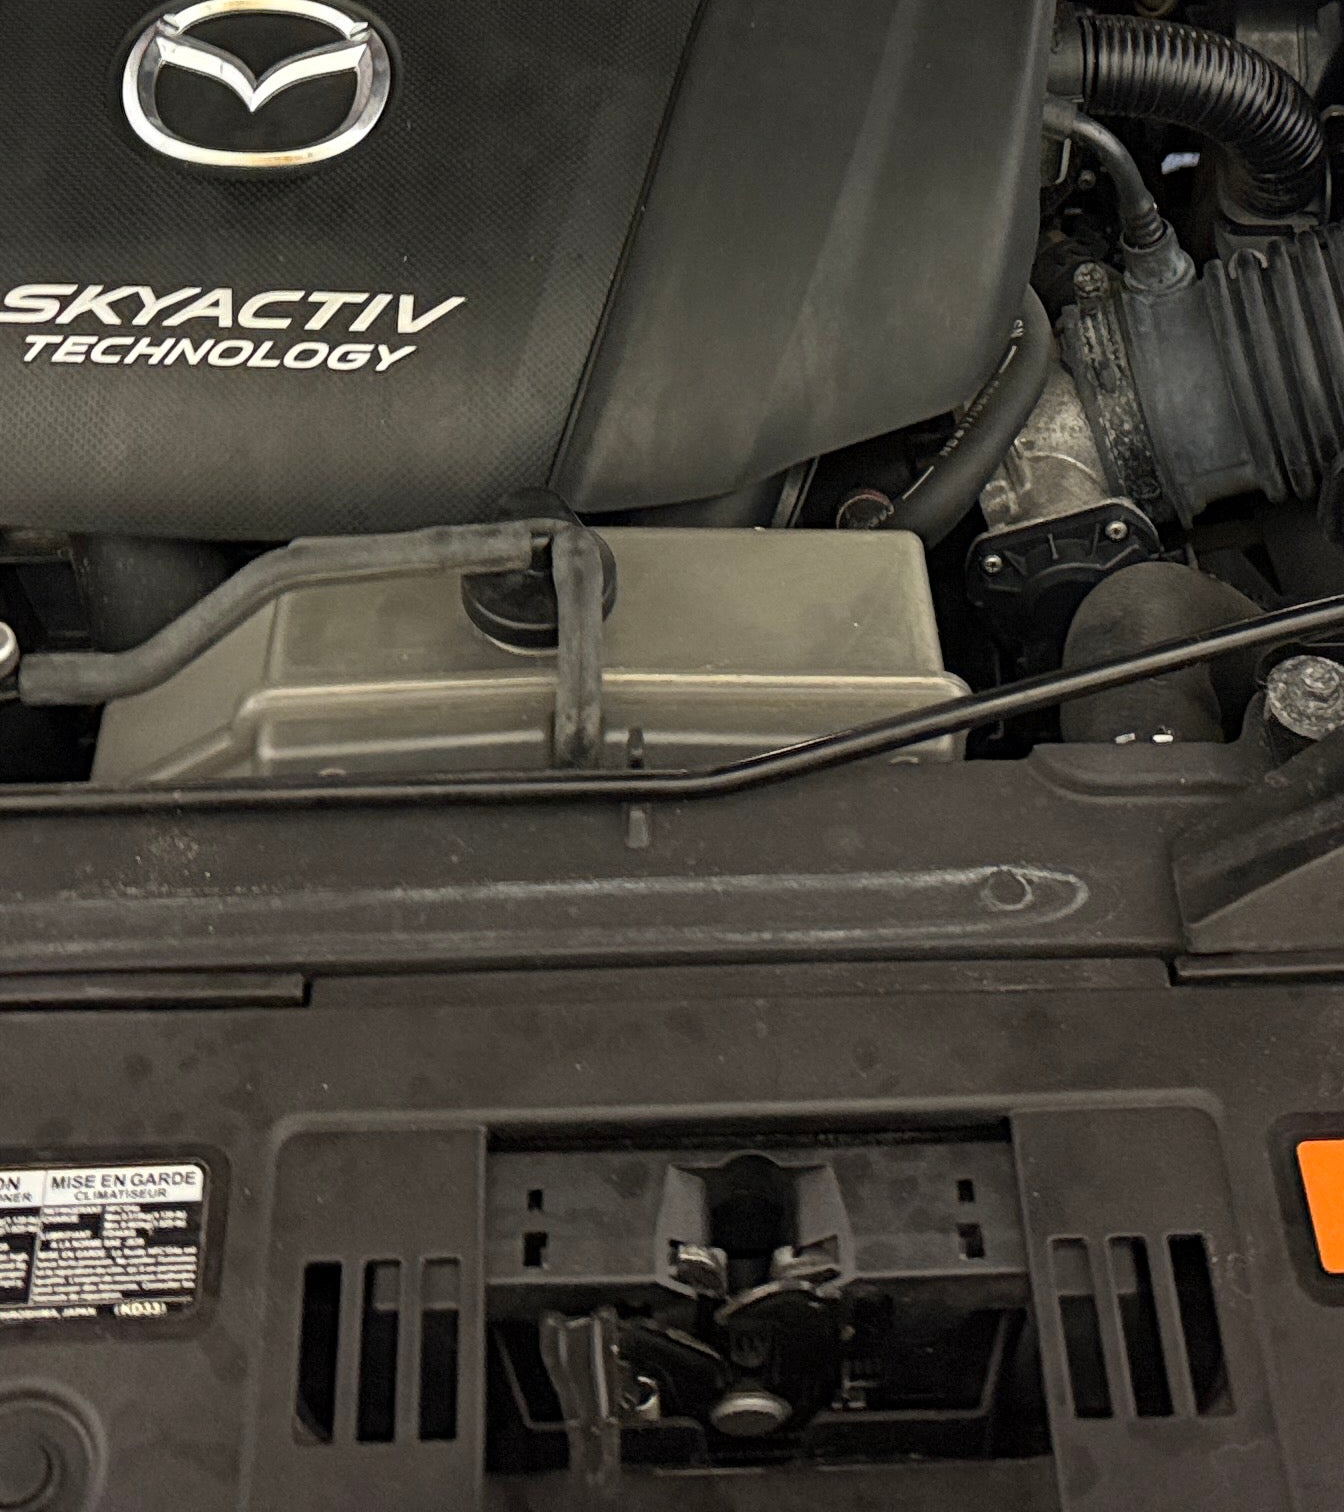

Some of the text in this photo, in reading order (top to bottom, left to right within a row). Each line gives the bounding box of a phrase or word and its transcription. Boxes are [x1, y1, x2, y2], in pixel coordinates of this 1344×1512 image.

[23, 334, 418, 372] TECHNOLOGY
[51, 1171, 197, 1190] MISE EN GARDE
[74, 1188, 167, 1202] CLIMATISEUR
